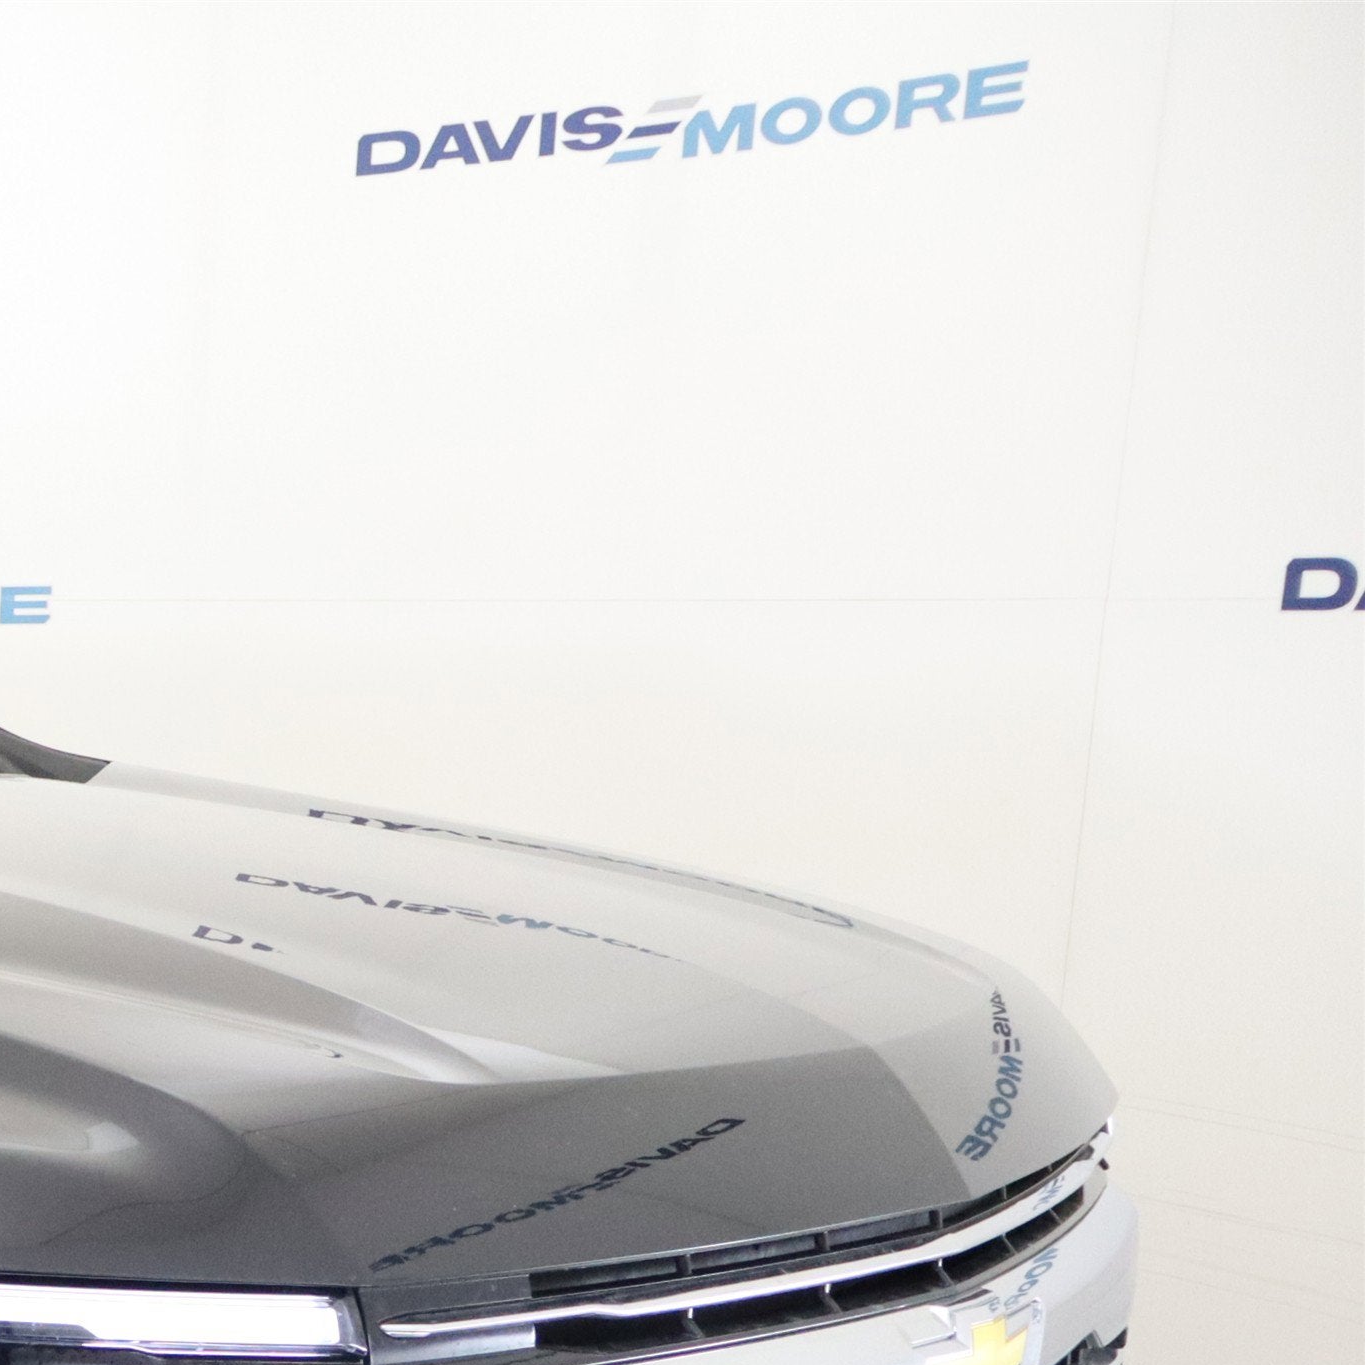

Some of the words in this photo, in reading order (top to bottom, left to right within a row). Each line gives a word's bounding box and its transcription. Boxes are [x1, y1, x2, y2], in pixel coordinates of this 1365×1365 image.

[355, 105, 625, 177] DAVIS
[681, 59, 1030, 159] MOORE
[1280, 556, 1365, 611] D
